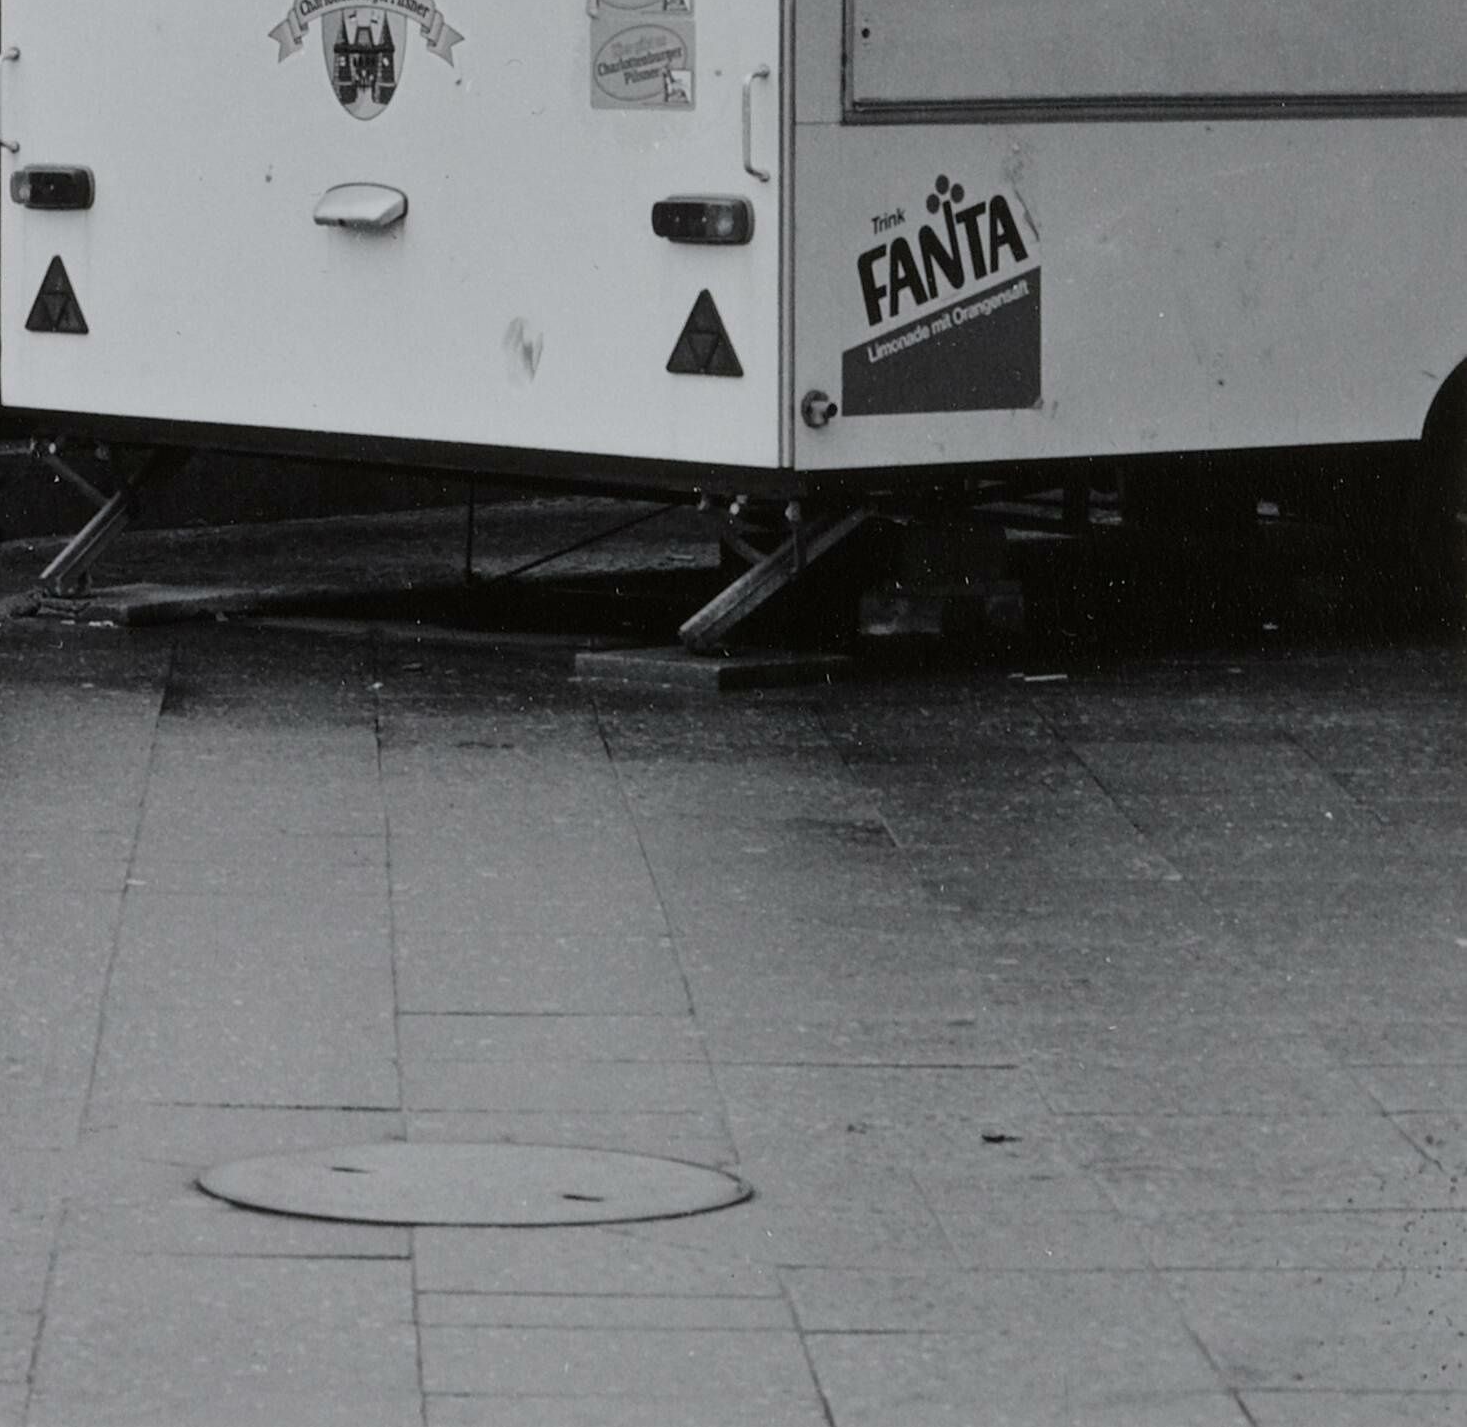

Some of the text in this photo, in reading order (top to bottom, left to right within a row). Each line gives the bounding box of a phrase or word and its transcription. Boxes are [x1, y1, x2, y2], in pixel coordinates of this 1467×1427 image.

[871, 208, 907, 235] Trink
[857, 194, 1029, 327] FANTA
[867, 324, 932, 364] Limonade
[930, 312, 953, 335] mit
